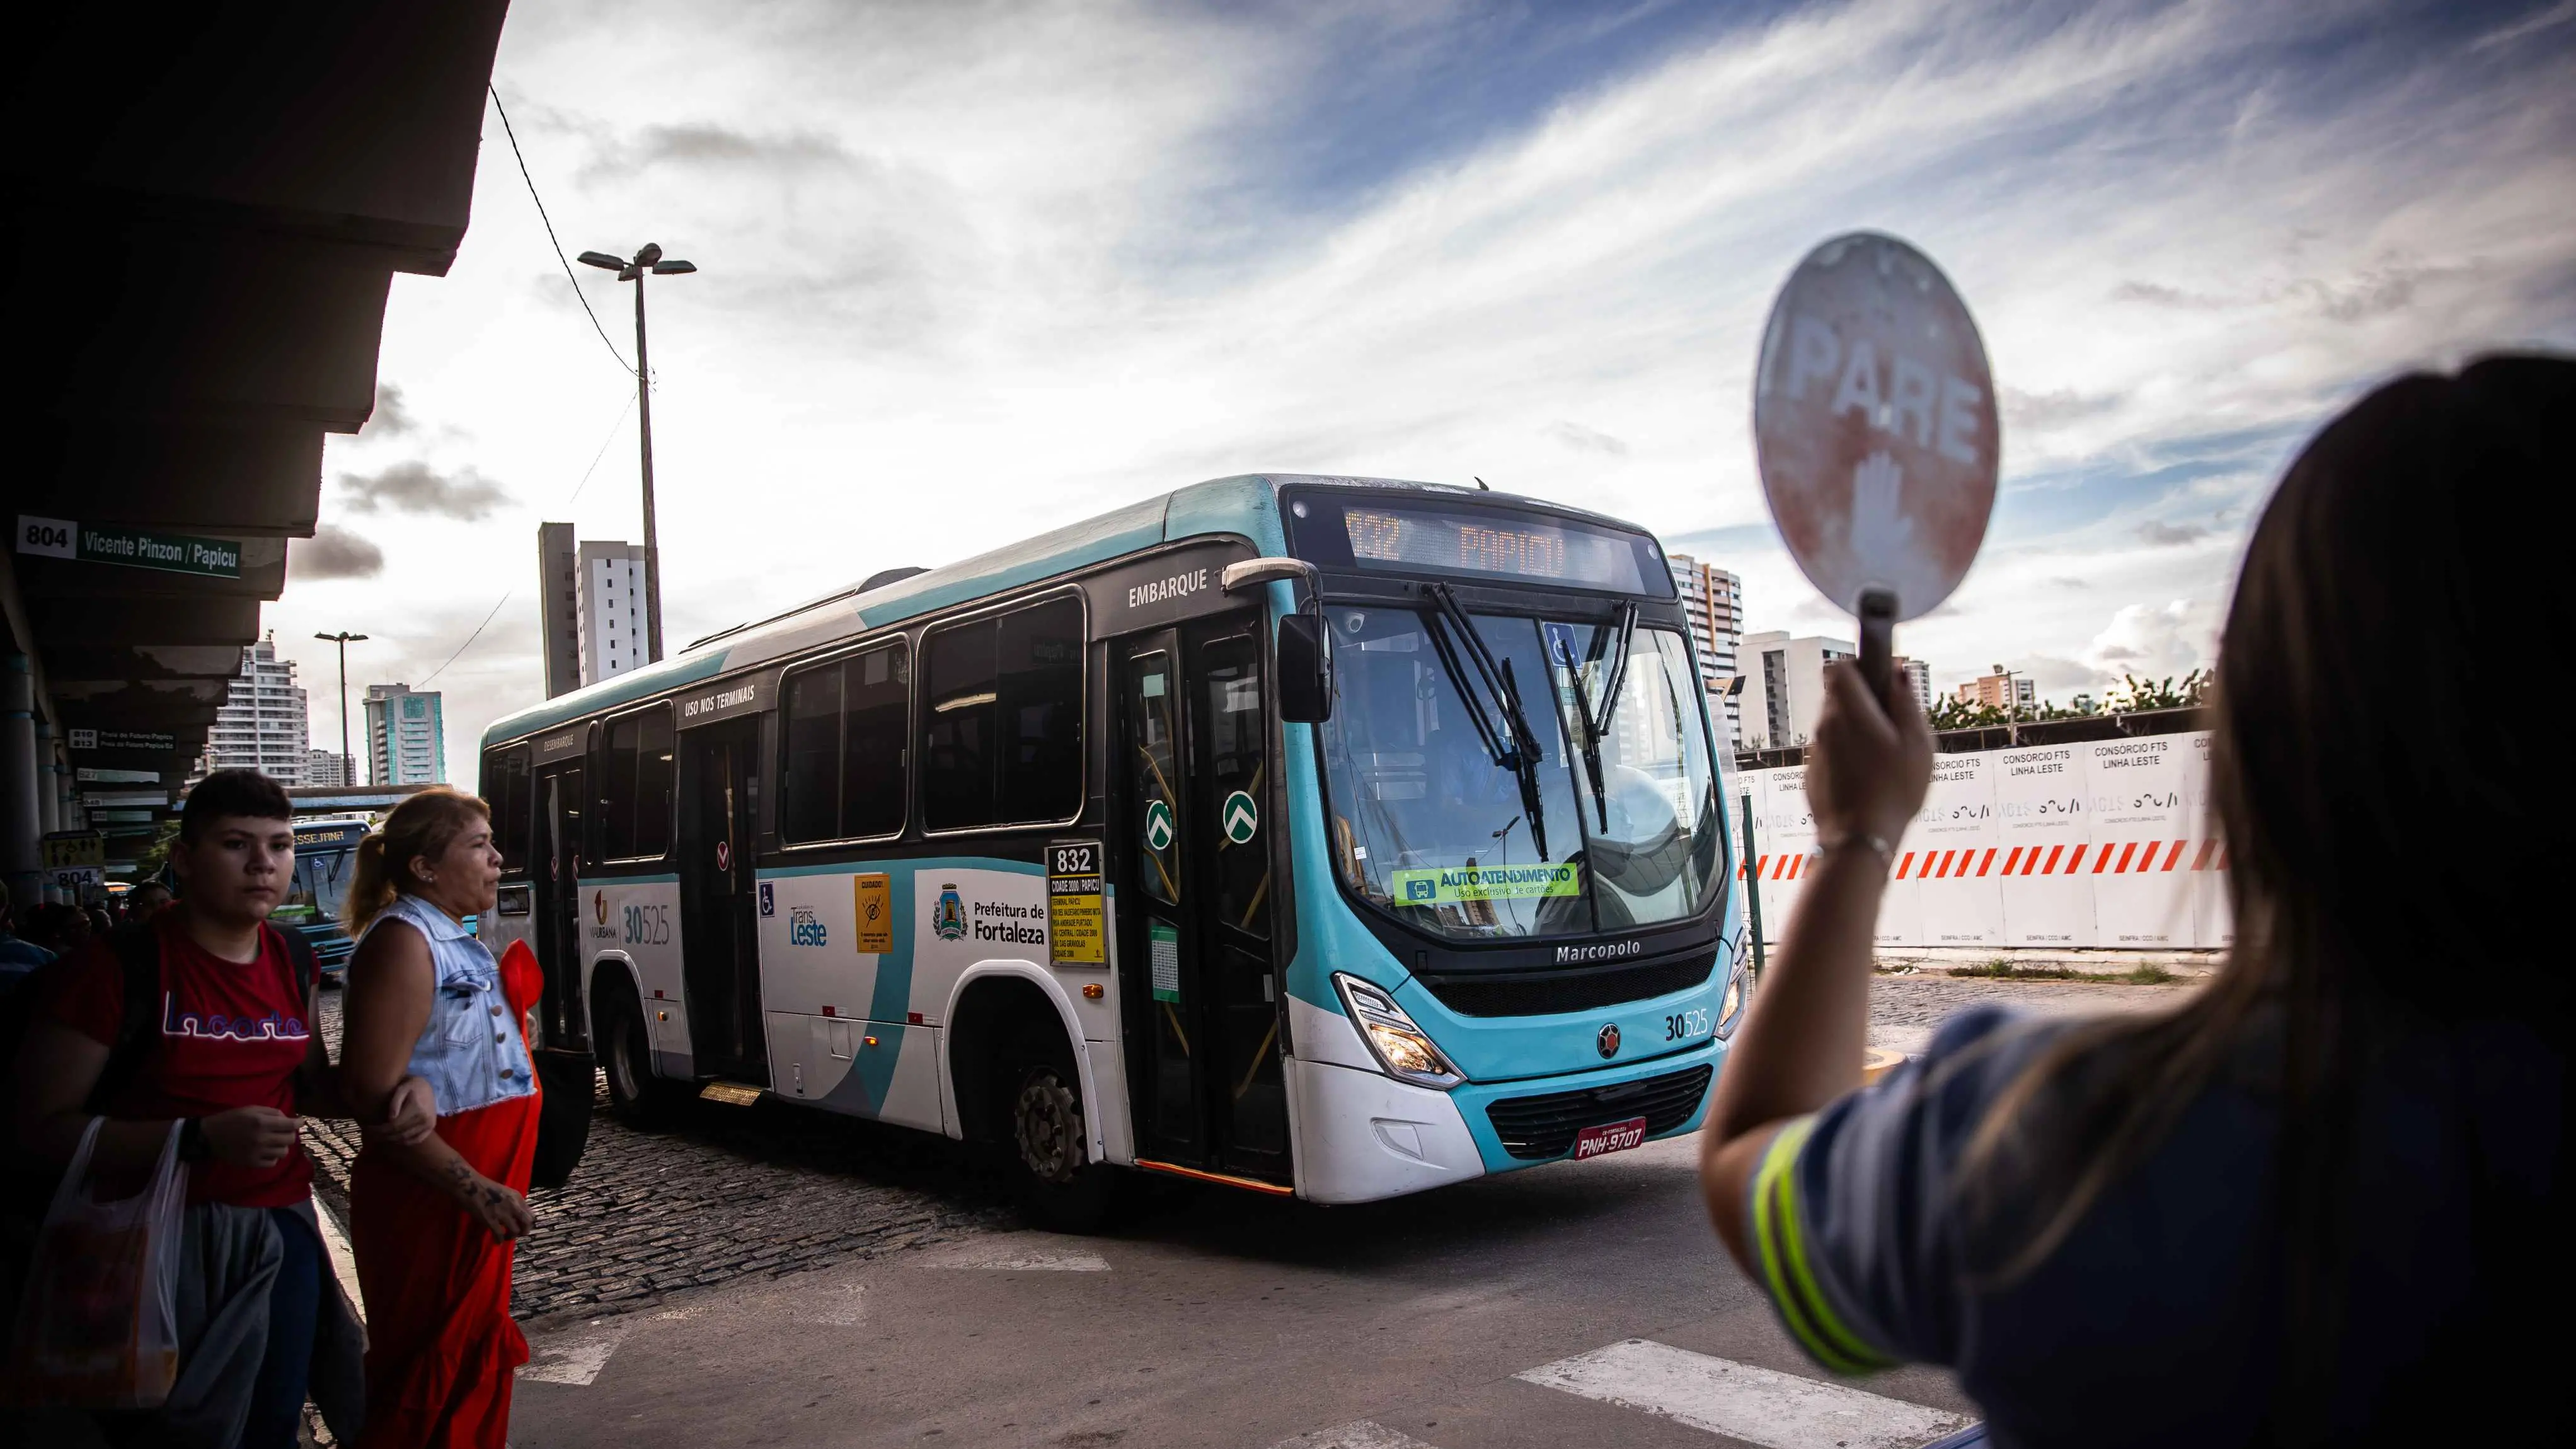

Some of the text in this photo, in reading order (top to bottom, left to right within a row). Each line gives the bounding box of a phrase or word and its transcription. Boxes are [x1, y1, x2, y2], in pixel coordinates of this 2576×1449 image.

[1788, 317, 1982, 465] PARE
[26, 524, 68, 548] 804
[85, 531, 134, 556] Vicente
[138, 538, 182, 562] Pinzon
[193, 544, 236, 570] Papicu
[1461, 526, 1563, 577] PAPICU
[1129, 569, 1207, 608] EMBARQUE
[685, 685, 754, 717] USO NOS TERMINAIS
[544, 734, 574, 752] DESEMBARQUE
[2095, 742, 2168, 756] CONSÓRCIO FTS
[1931, 758, 1981, 771] NSÓRCIO FTS
[2003, 750, 2071, 765] CONSÓRCIO FTS
[2103, 756, 2160, 768] LINHA LESTE
[1773, 770, 1806, 782] CONSÓRC
[1929, 771, 1974, 783] INHA LESTE
[2011, 763, 2063, 776] LINHA LESTE
[1779, 783, 1798, 792] LINHA
[293, 831, 344, 845] ESSEJANA
[1057, 848, 1091, 872] 832
[58, 871, 92, 886] 804
[1052, 880, 1068, 892] CIDADE
[1068, 879, 1079, 892] 2000
[1081, 879, 1100, 891] PAPICU
[1440, 868, 1570, 887] AUTOATENDIMENTO
[1454, 889, 1471, 898] Uso
[1473, 887, 1512, 897] exclusivo
[1526, 884, 1554, 894] cartões
[790, 906, 814, 924] Trans
[974, 902, 1044, 919] Prefeitura de
[624, 905, 669, 945] 30525
[790, 916, 827, 947] Leste
[975, 920, 1045, 945] Fortaleza
[1556, 940, 1640, 962] Marcopolo
[1665, 1008, 1708, 1041] 30525
